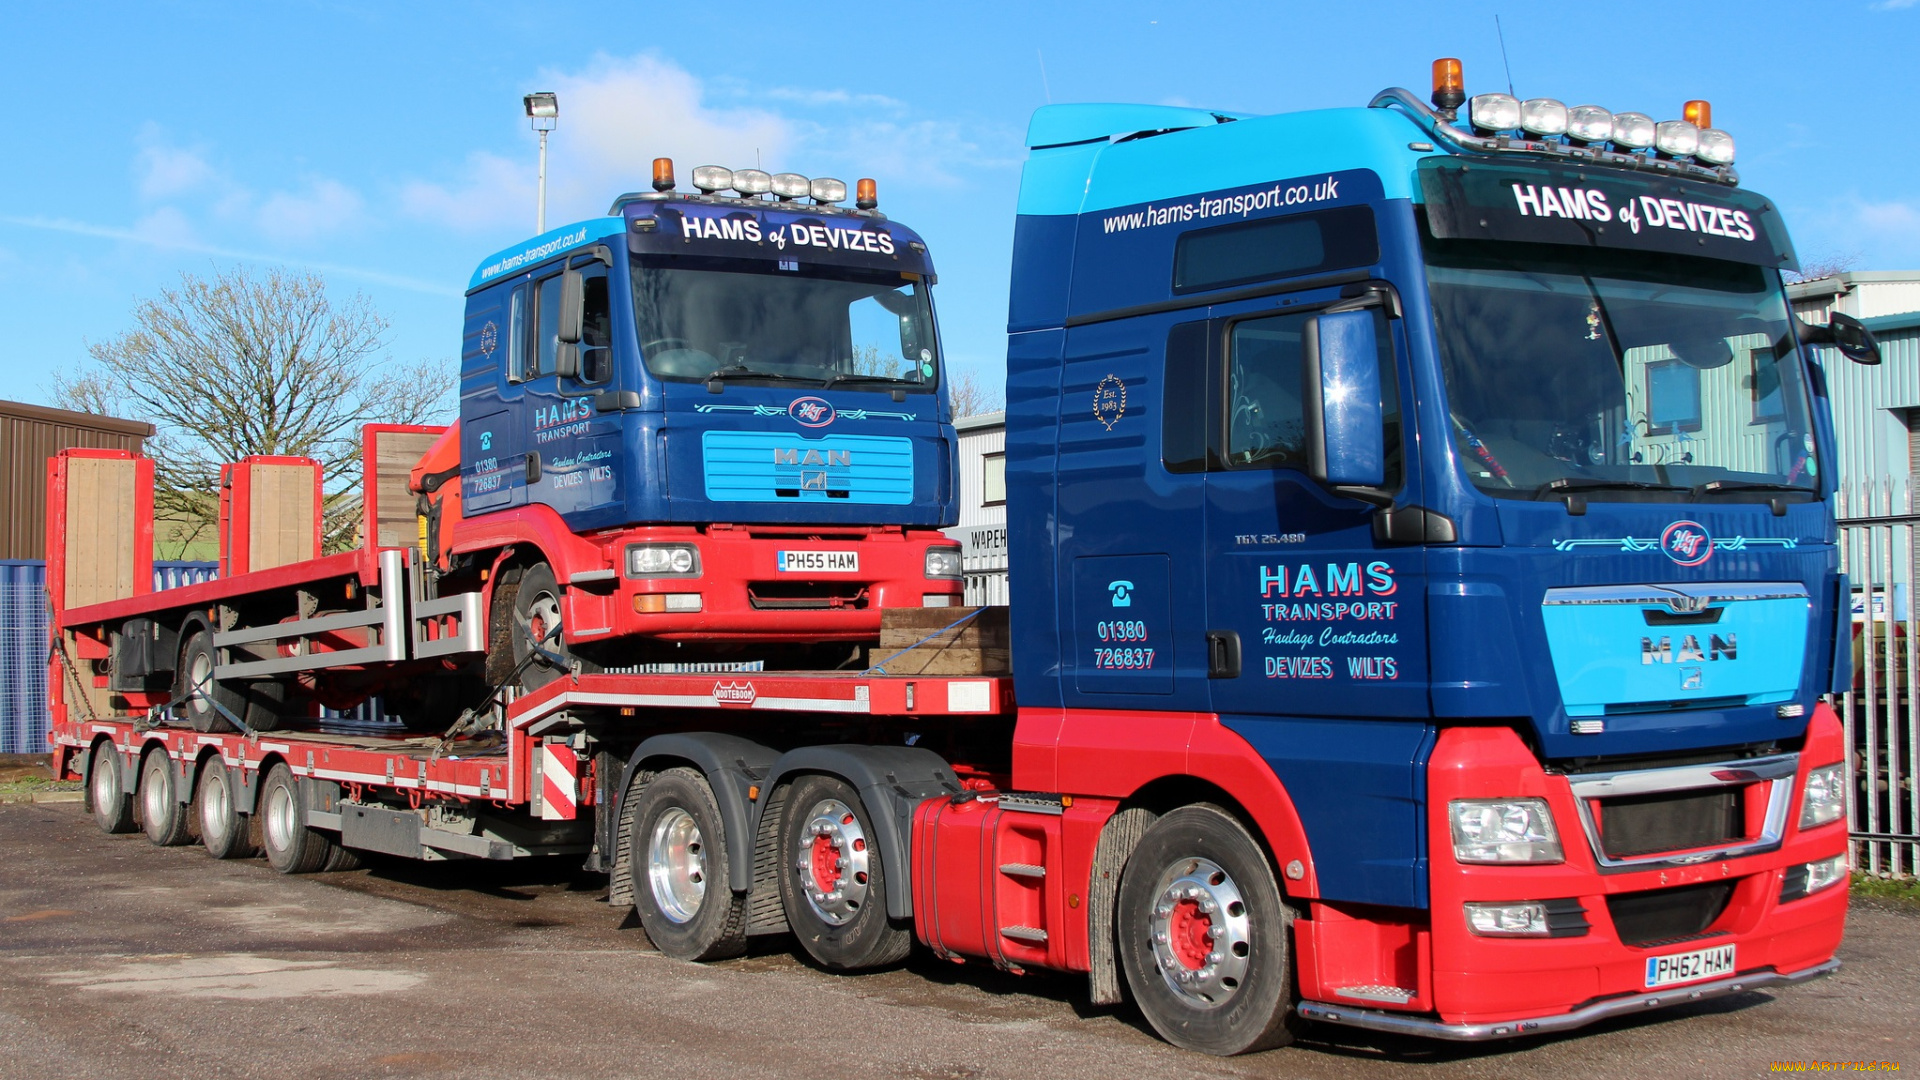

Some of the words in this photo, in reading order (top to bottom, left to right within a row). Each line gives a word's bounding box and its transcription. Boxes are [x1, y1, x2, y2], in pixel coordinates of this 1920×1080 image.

[1103, 176, 1338, 234] www.hams-transport.co.uk
[1512, 184, 1612, 222] HAMS
[1619, 199, 1640, 234] of
[1639, 196, 1755, 242] DEVIZES
[681, 216, 762, 242] HAMS
[768, 226, 787, 250] of
[790, 223, 895, 254] DEVIZES
[482, 227, 587, 279] www.hams-transport.co.uk
[1103, 389, 1117, 399] Est.
[535, 396, 592, 430] HAMS
[1101, 400, 1117, 411] 1983
[536, 420, 591, 444] TRANSPORT
[475, 456, 498, 474] 01380
[576, 450, 612, 466] Contractors
[774, 448, 850, 466] MAN
[474, 475, 501, 494] 726837
[553, 470, 583, 489] DEVIZES
[589, 466, 612, 482] WILTS
[1235, 534, 1258, 544] TGX
[787, 552, 824, 569] PH55
[828, 552, 856, 568] HAM
[1259, 561, 1398, 598] HAMS
[1261, 601, 1398, 621] TRANSPORT
[1097, 620, 1147, 642] 01380
[1262, 627, 1315, 650] Haulage
[1319, 627, 1398, 647] Contractors
[1094, 648, 1155, 669] 726837
[1640, 632, 1737, 665] MAN
[1265, 656, 1333, 679] DEVIZES
[1347, 656, 1398, 680] WILTS
[715, 689, 753, 699] NOOTEBOOM
[1657, 953, 1700, 982] PH62
[1704, 947, 1733, 974] HAM
